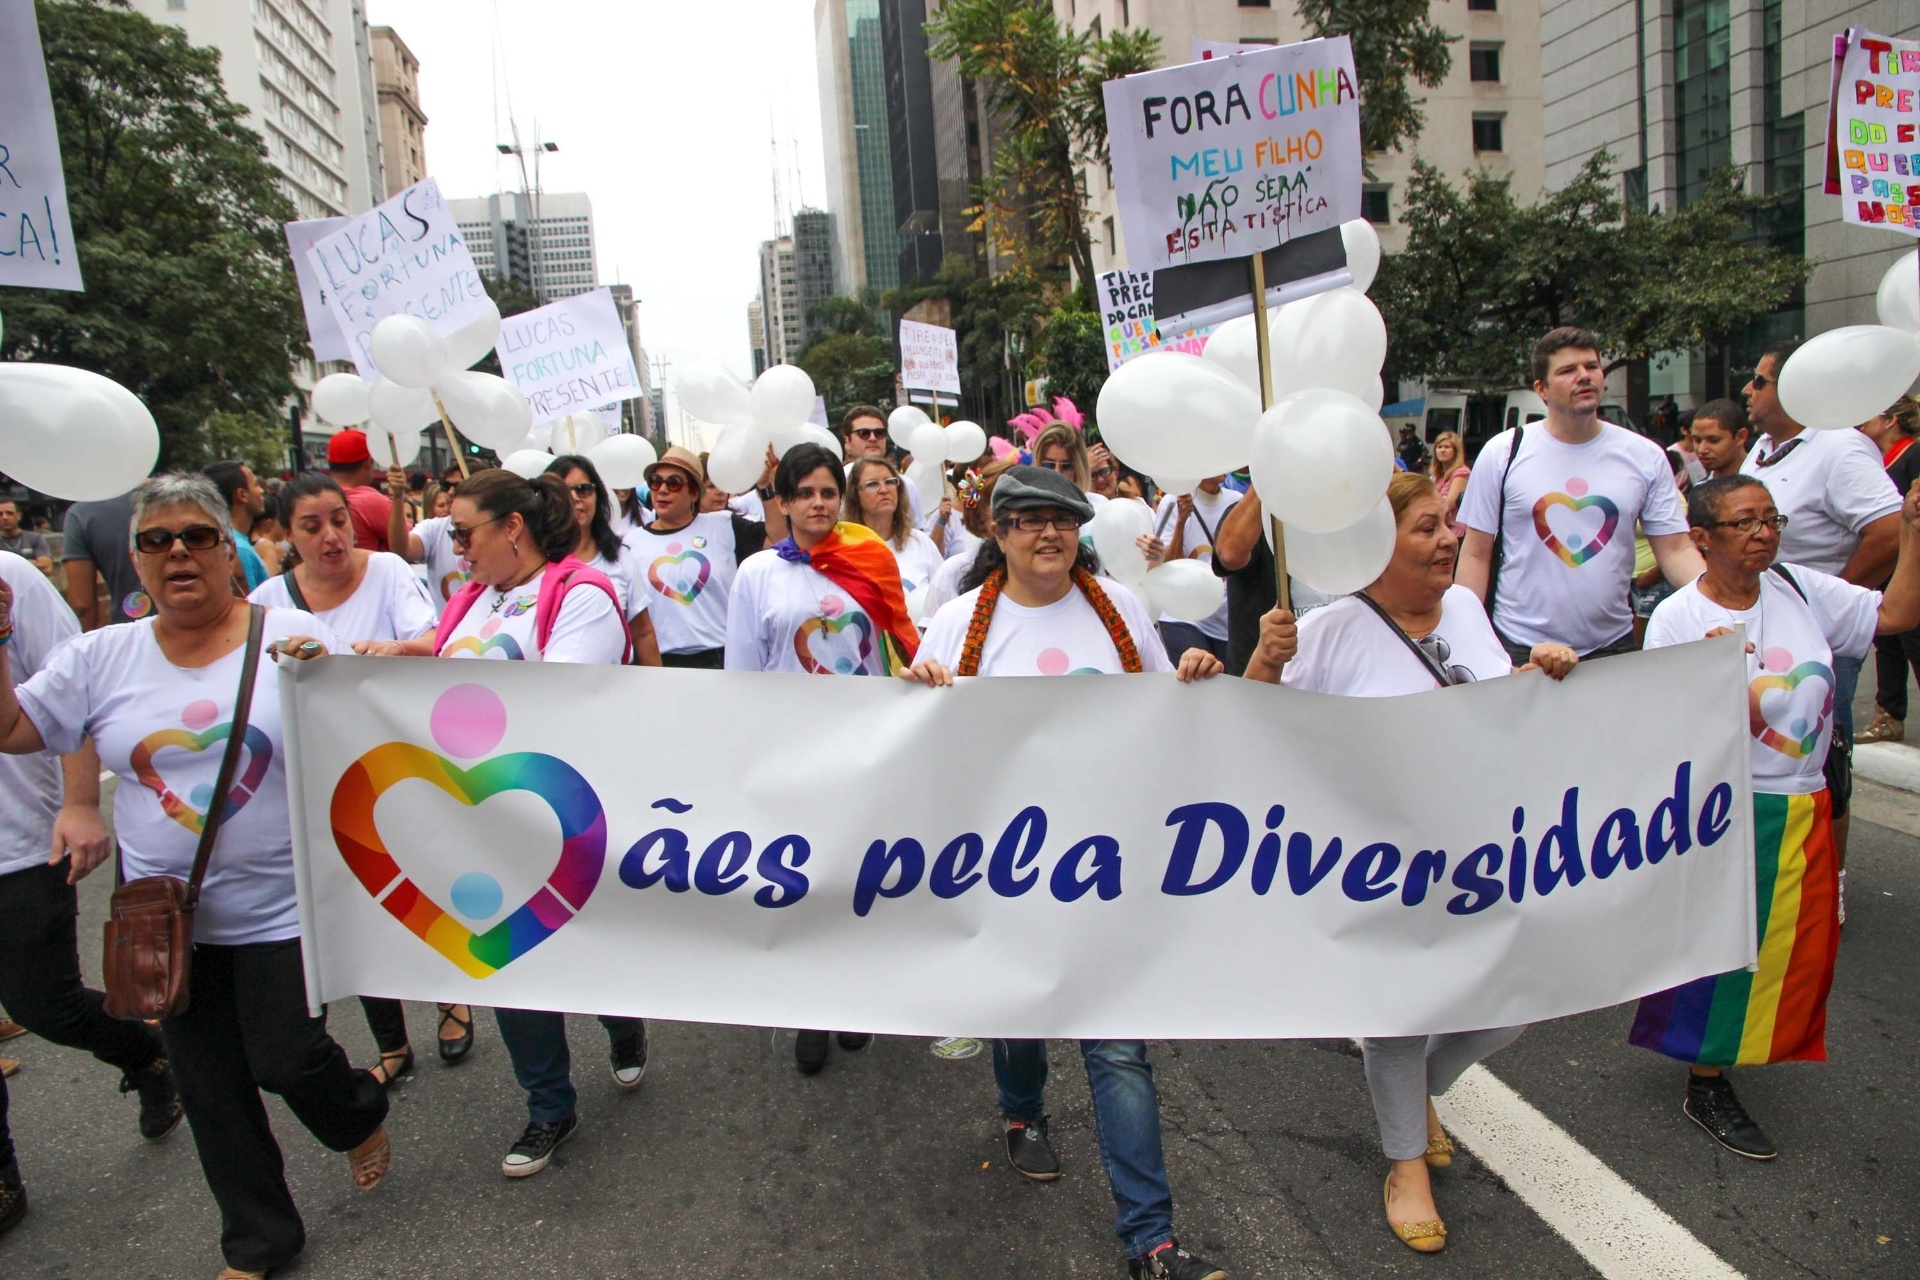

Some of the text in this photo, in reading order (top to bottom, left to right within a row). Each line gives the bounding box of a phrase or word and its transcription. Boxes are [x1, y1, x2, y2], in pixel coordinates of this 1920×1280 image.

[1142, 67, 1356, 139] FORA CUNHA
[1850, 118, 1888, 146] DO
[1170, 147, 1244, 182] MEU
[1176, 165, 1313, 222] NÃO SERÁ
[316, 188, 430, 291] LUCAS
[340, 232, 462, 322] FORTUNA
[502, 312, 576, 354] LUCAS
[902, 326, 930, 343] TIRE
[1107, 310, 1126, 326] DO
[512, 340, 608, 387] FORTUNA
[618, 760, 1733, 918] ães pela Diversidade
